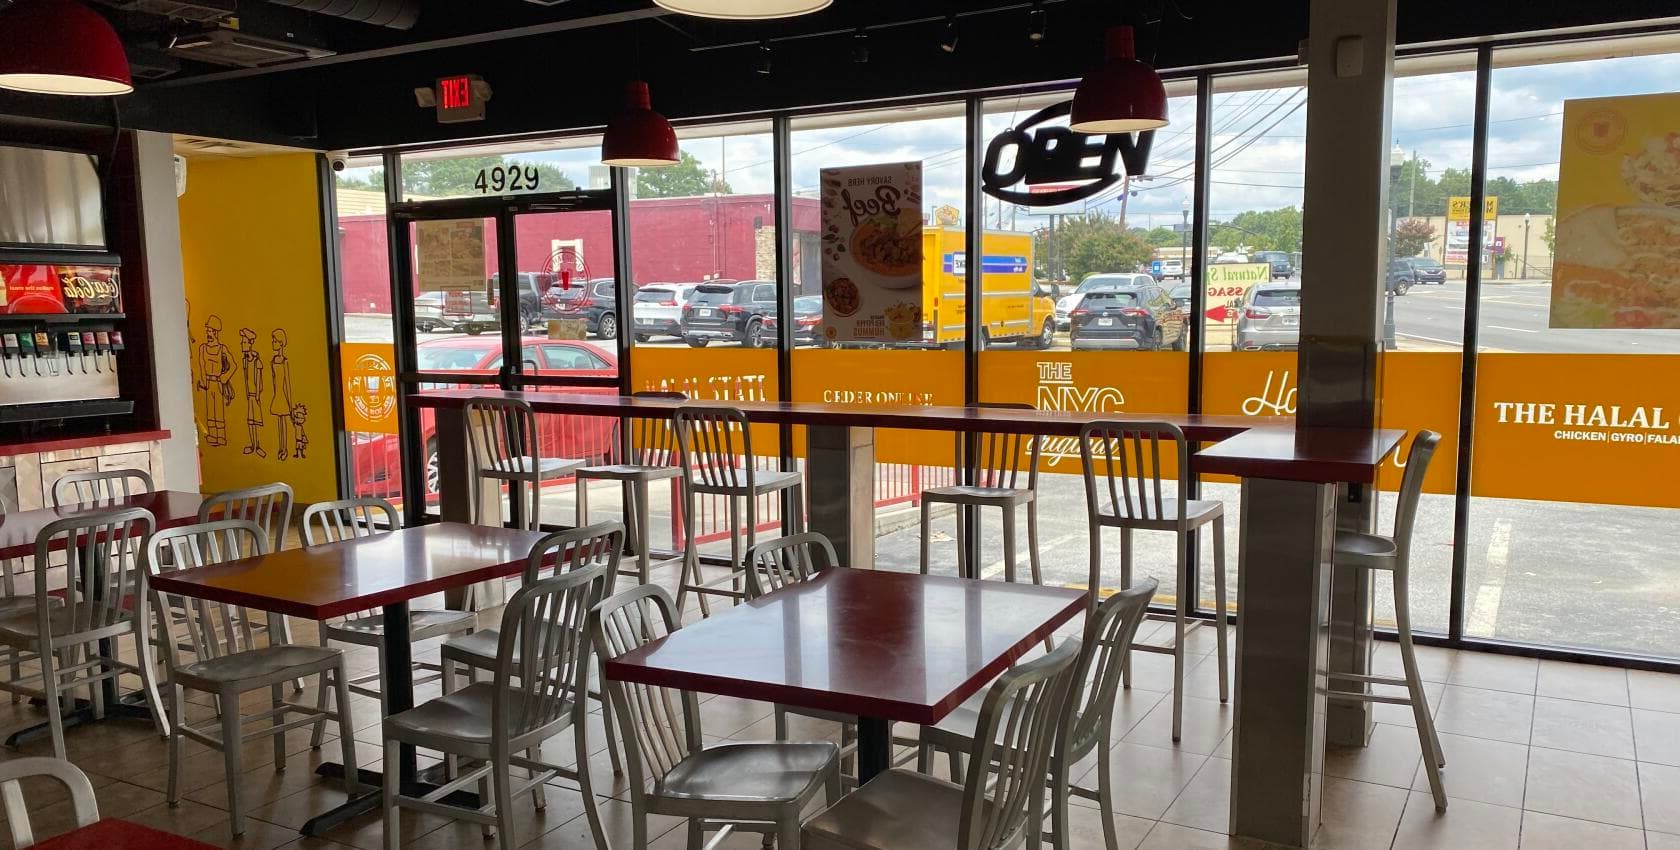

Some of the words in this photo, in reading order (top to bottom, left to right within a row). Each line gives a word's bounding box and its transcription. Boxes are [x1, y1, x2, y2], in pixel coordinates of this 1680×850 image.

[982, 126, 1157, 187] OPEN
[474, 165, 540, 194] 4929
[1037, 361, 1073, 380] THE
[1037, 386, 1125, 412] NYC
[1493, 401, 1556, 425] THE
[1563, 404, 1670, 429] HALAL
[1554, 430, 1607, 442] CHICKEN
[1611, 432, 1644, 444] GYRO
